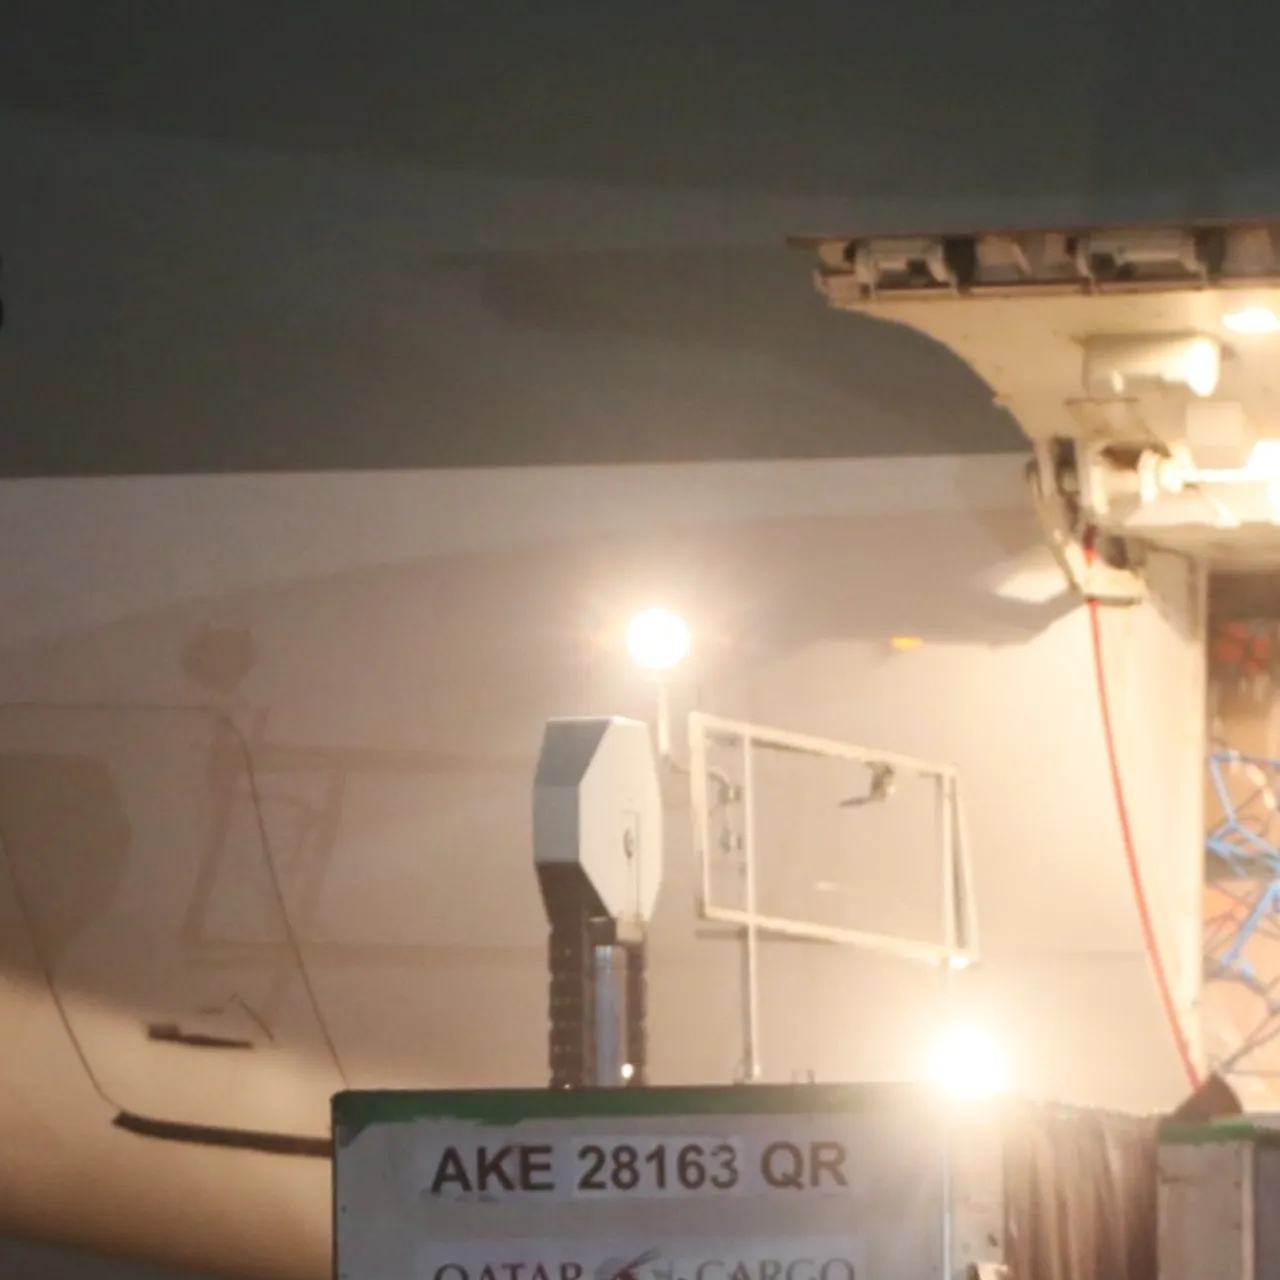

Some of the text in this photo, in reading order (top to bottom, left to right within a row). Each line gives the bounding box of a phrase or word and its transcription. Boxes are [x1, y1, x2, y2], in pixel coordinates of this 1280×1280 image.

[430, 1141, 849, 1192] AKE 28163 QR
